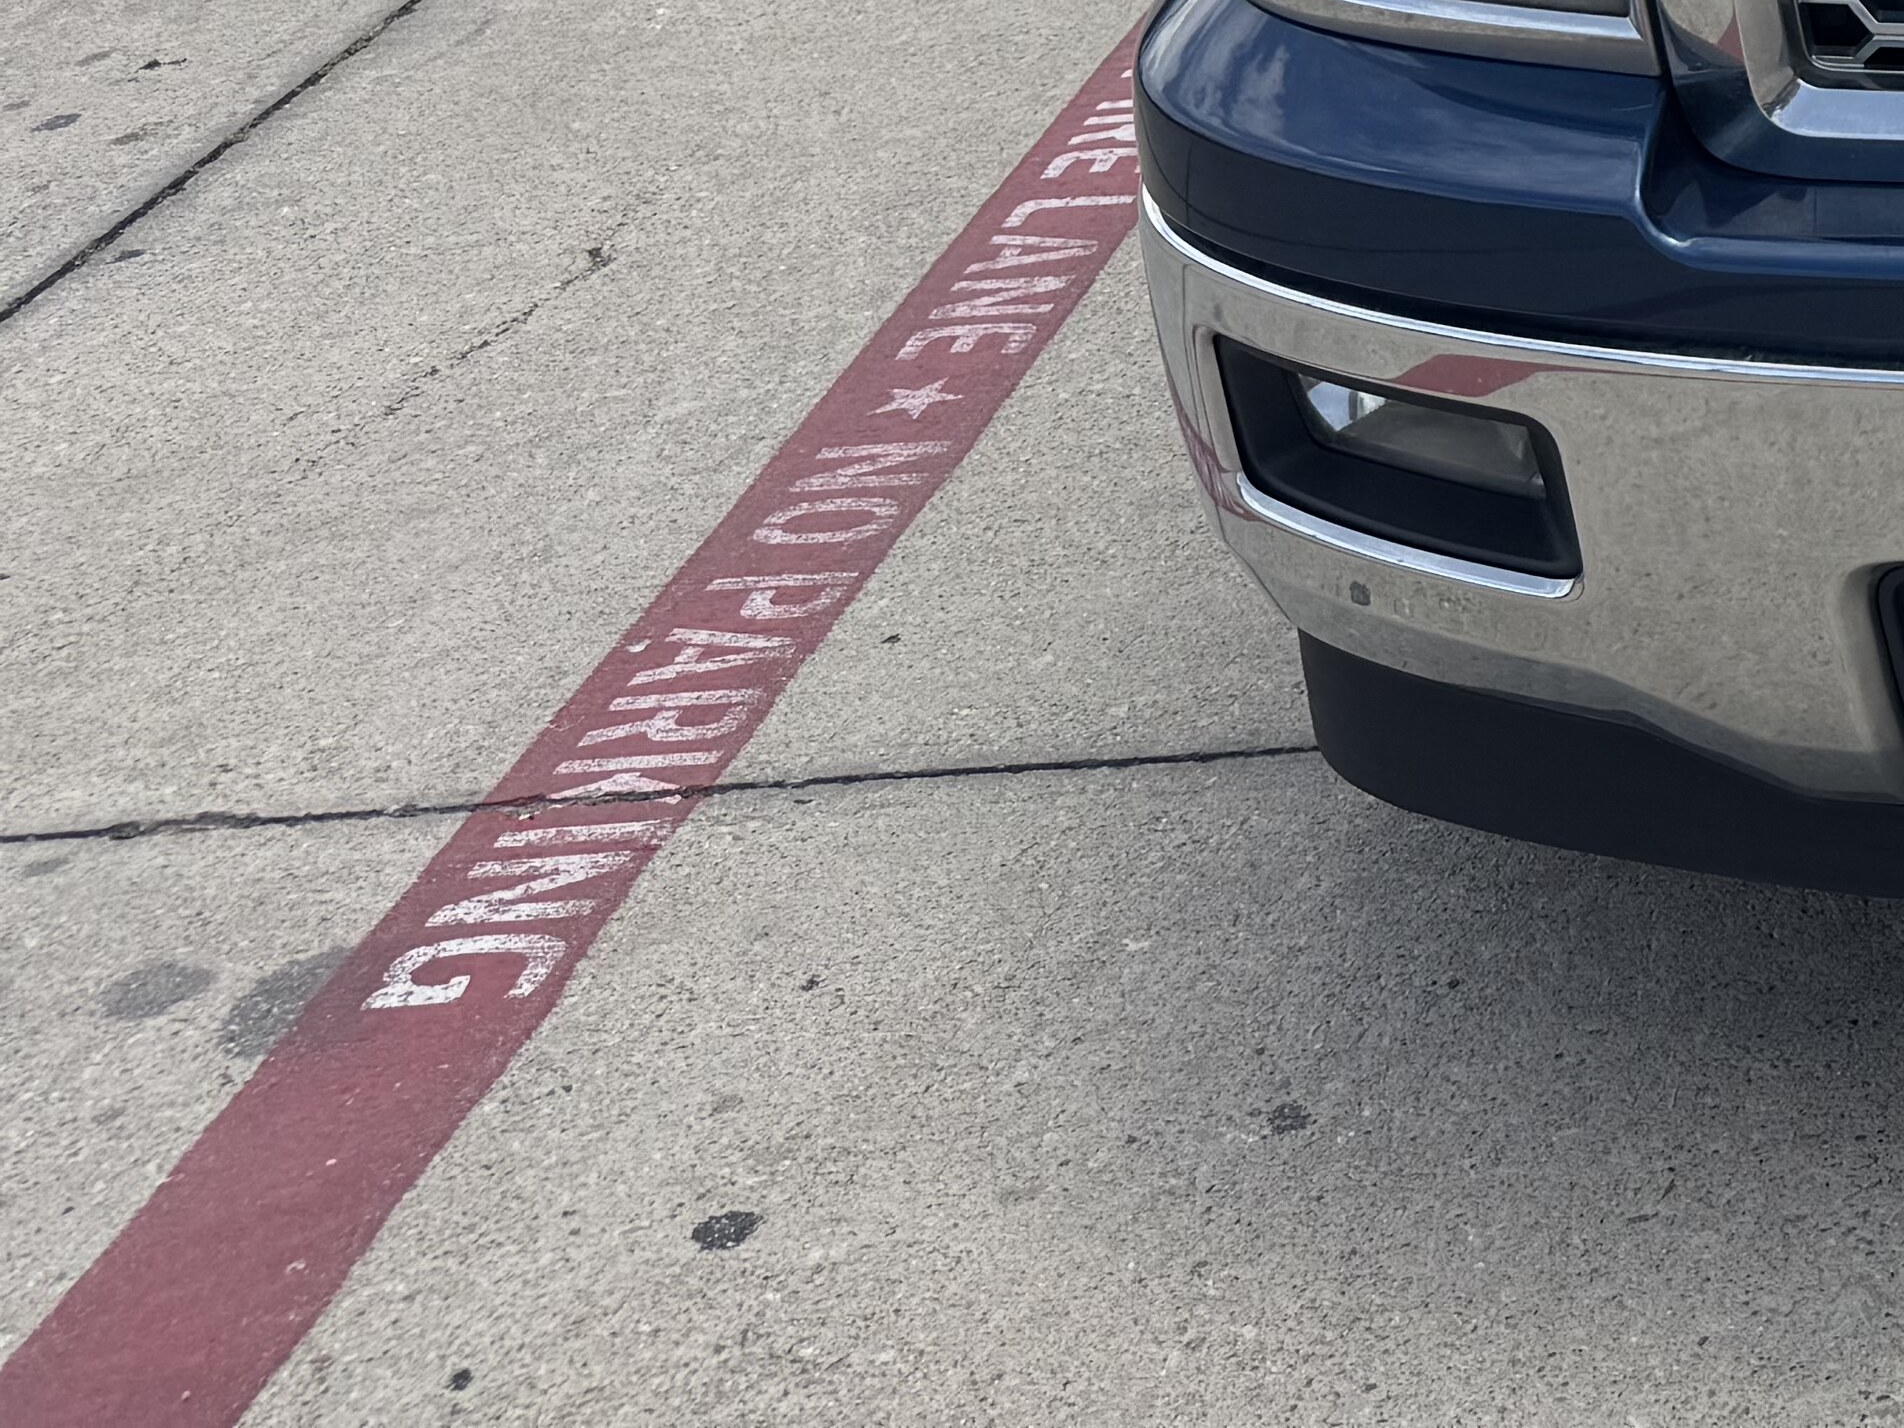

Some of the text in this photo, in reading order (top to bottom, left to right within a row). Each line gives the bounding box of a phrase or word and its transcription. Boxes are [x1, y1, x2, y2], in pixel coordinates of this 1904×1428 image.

[894, 194, 1138, 361] LANE
[752, 441, 951, 544] NO
[360, 571, 860, 1011] PARKING
